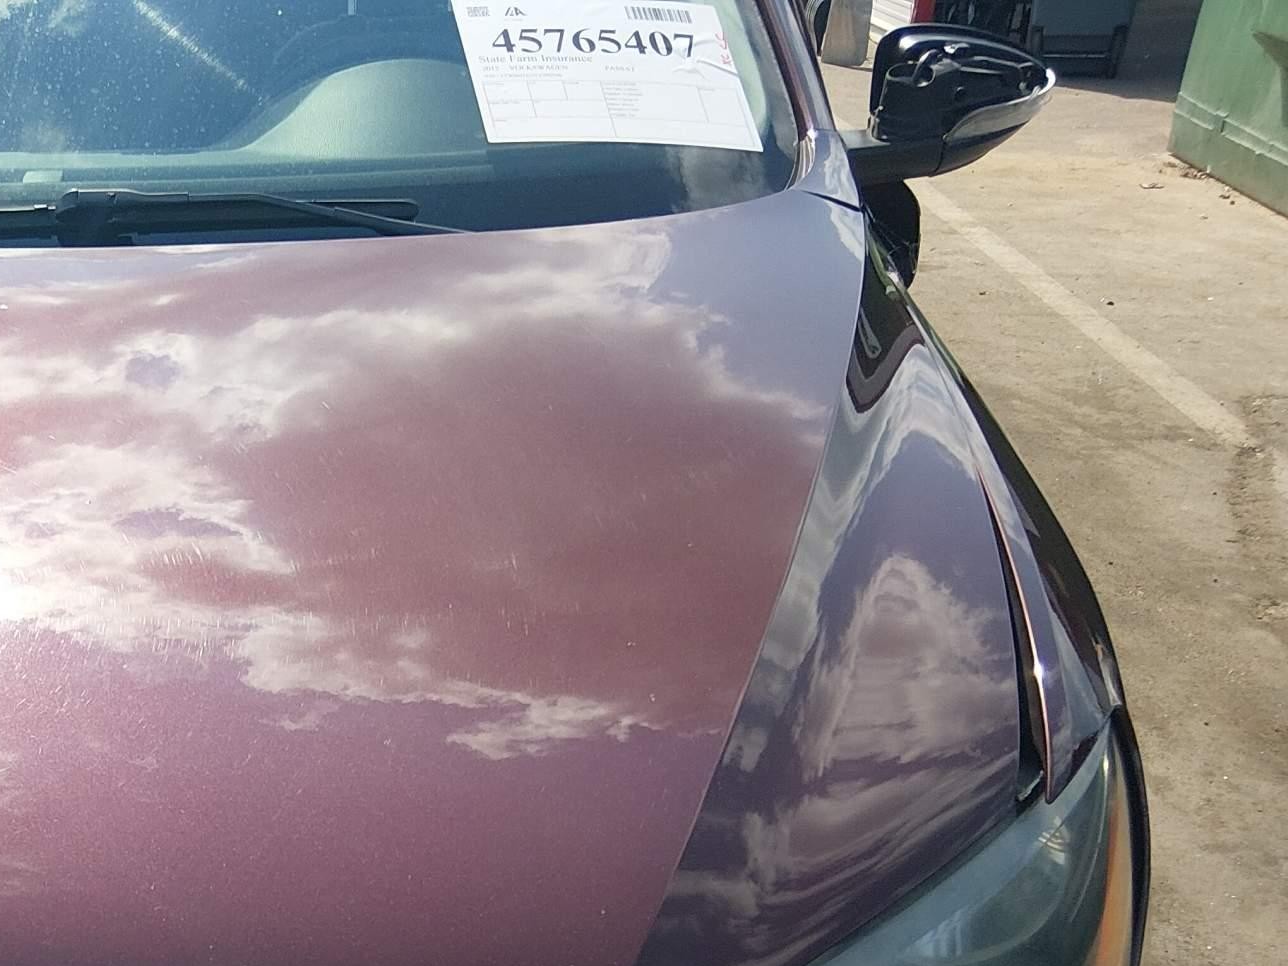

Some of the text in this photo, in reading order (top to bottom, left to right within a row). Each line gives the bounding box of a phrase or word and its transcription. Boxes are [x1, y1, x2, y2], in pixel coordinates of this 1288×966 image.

[492, 28, 694, 58] 45765407
[479, 54, 593, 63] State Farm Insurance
